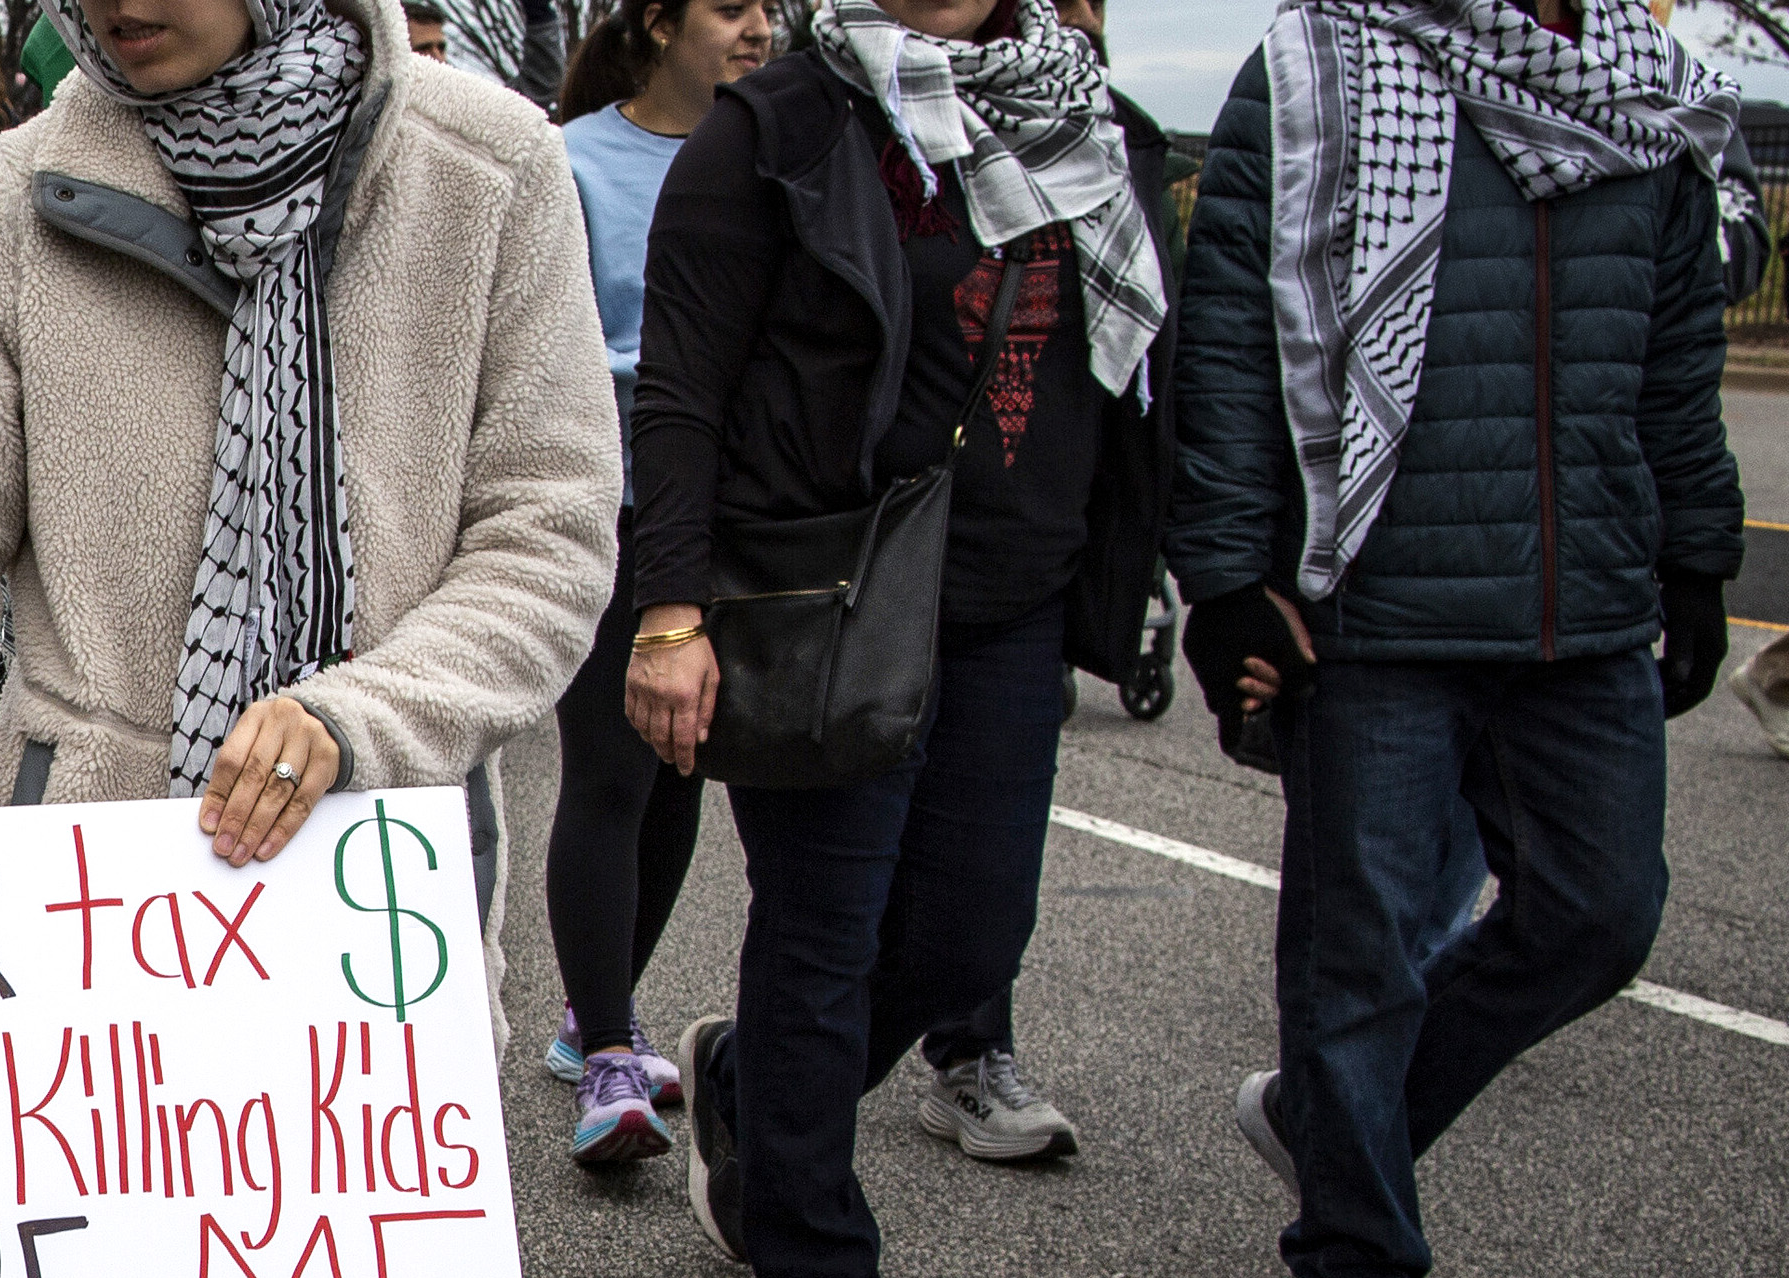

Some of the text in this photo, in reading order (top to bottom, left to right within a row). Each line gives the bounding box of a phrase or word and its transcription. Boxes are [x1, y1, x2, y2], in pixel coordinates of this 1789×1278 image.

[45, 823, 271, 991] tax
[333, 798, 449, 1022] $
[1, 1020, 282, 1250] Killing
[308, 1020, 480, 1198] Kids
